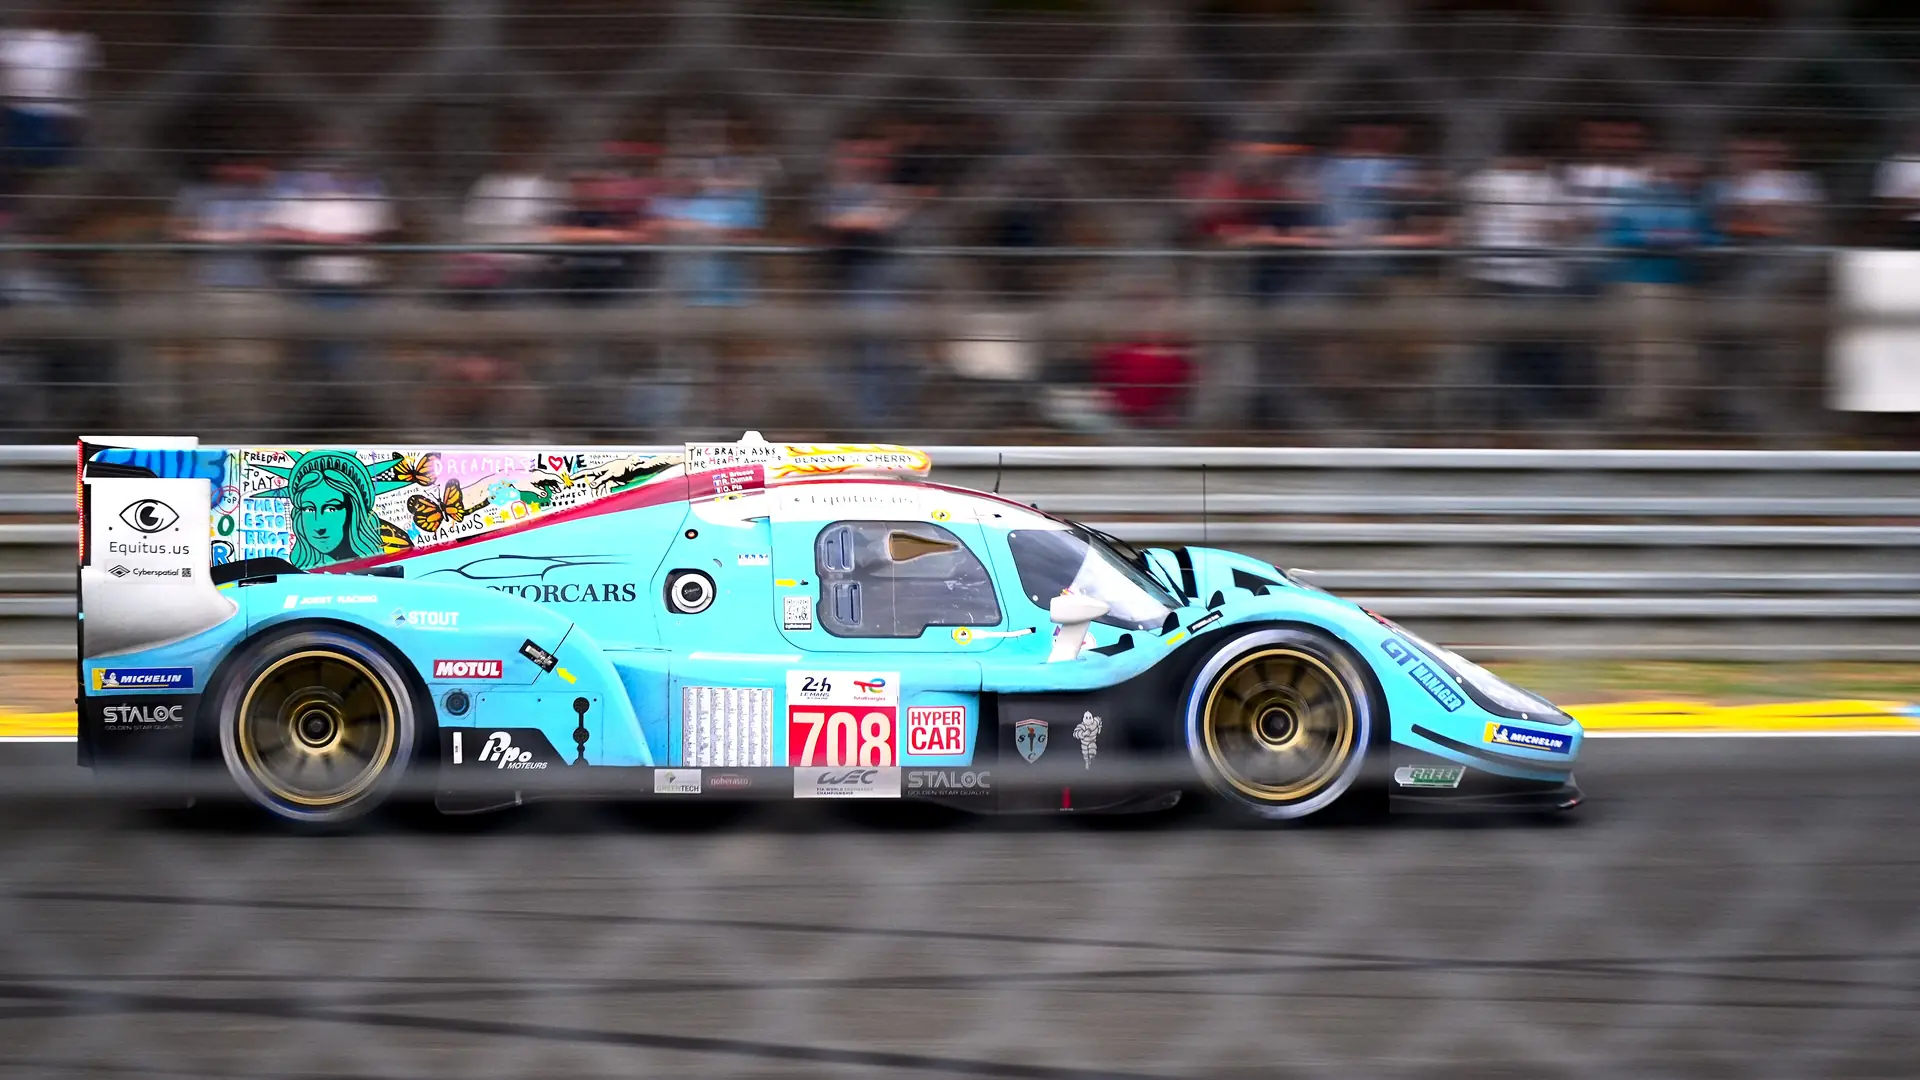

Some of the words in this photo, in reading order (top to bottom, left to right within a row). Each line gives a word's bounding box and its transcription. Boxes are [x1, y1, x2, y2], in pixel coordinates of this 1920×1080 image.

[243, 451, 286, 463] FREEDOM
[794, 455, 846, 463] BENSON
[866, 454, 913, 463] CHERRY
[243, 468, 259, 480] TO
[243, 475, 275, 491] PLAY
[109, 541, 190, 556] Equitus.us
[132, 568, 179, 577] Cyberspatial
[408, 611, 460, 626] STOUT
[1380, 637, 1420, 666] GT
[436, 661, 500, 676] MOTUL
[120, 674, 182, 683] MICHELIN
[1411, 664, 1463, 710] MANAGER
[103, 705, 184, 723] STALOC
[911, 711, 961, 726] HYPER
[792, 711, 892, 767] 708
[911, 727, 961, 750] CAR
[1510, 733, 1563, 748] MICHELIN
[507, 762, 548, 770] MOTEURS
[816, 769, 879, 785] WEC
[908, 771, 991, 788] STALOC
